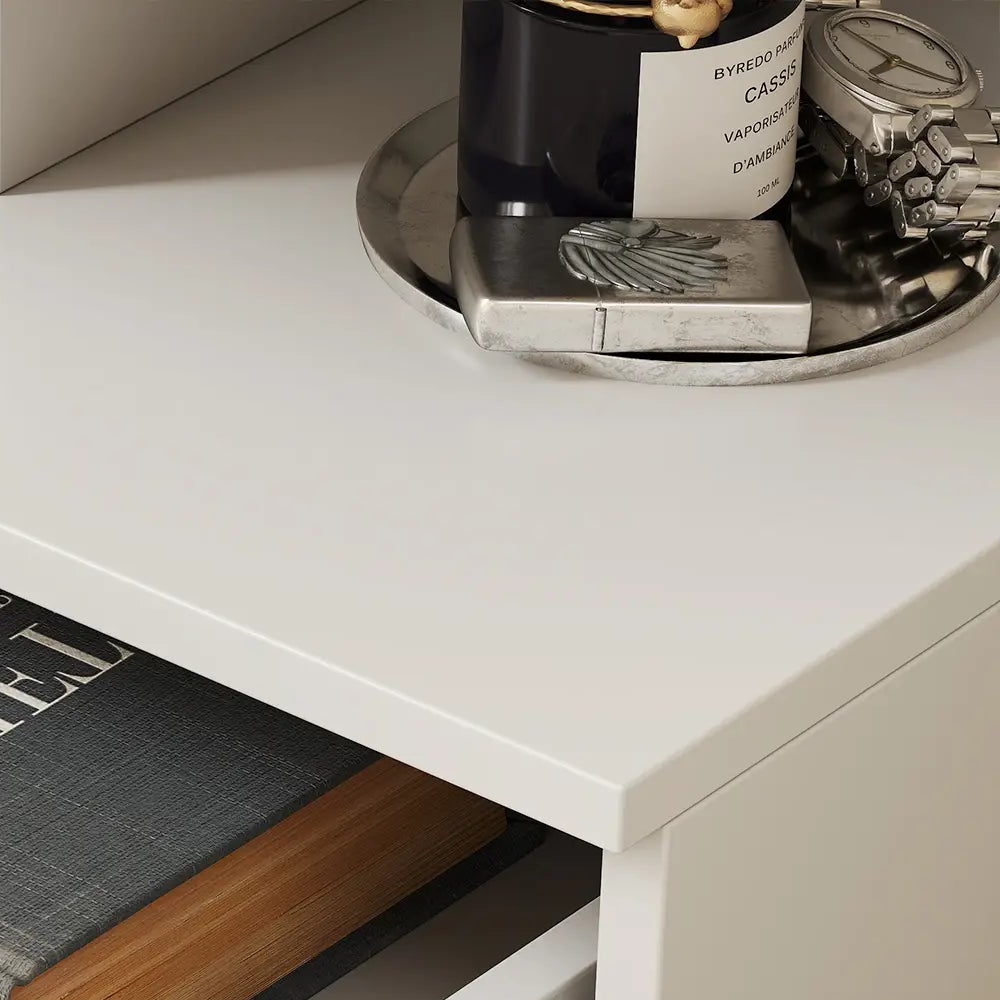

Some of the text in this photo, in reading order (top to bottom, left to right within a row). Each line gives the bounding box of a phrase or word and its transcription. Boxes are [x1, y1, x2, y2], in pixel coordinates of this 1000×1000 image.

[714, 50, 773, 80] BYREDO
[744, 59, 797, 104] CASSIS
[732, 124, 796, 174] D'AMBIANCE
[756, 184, 771, 198] 100
